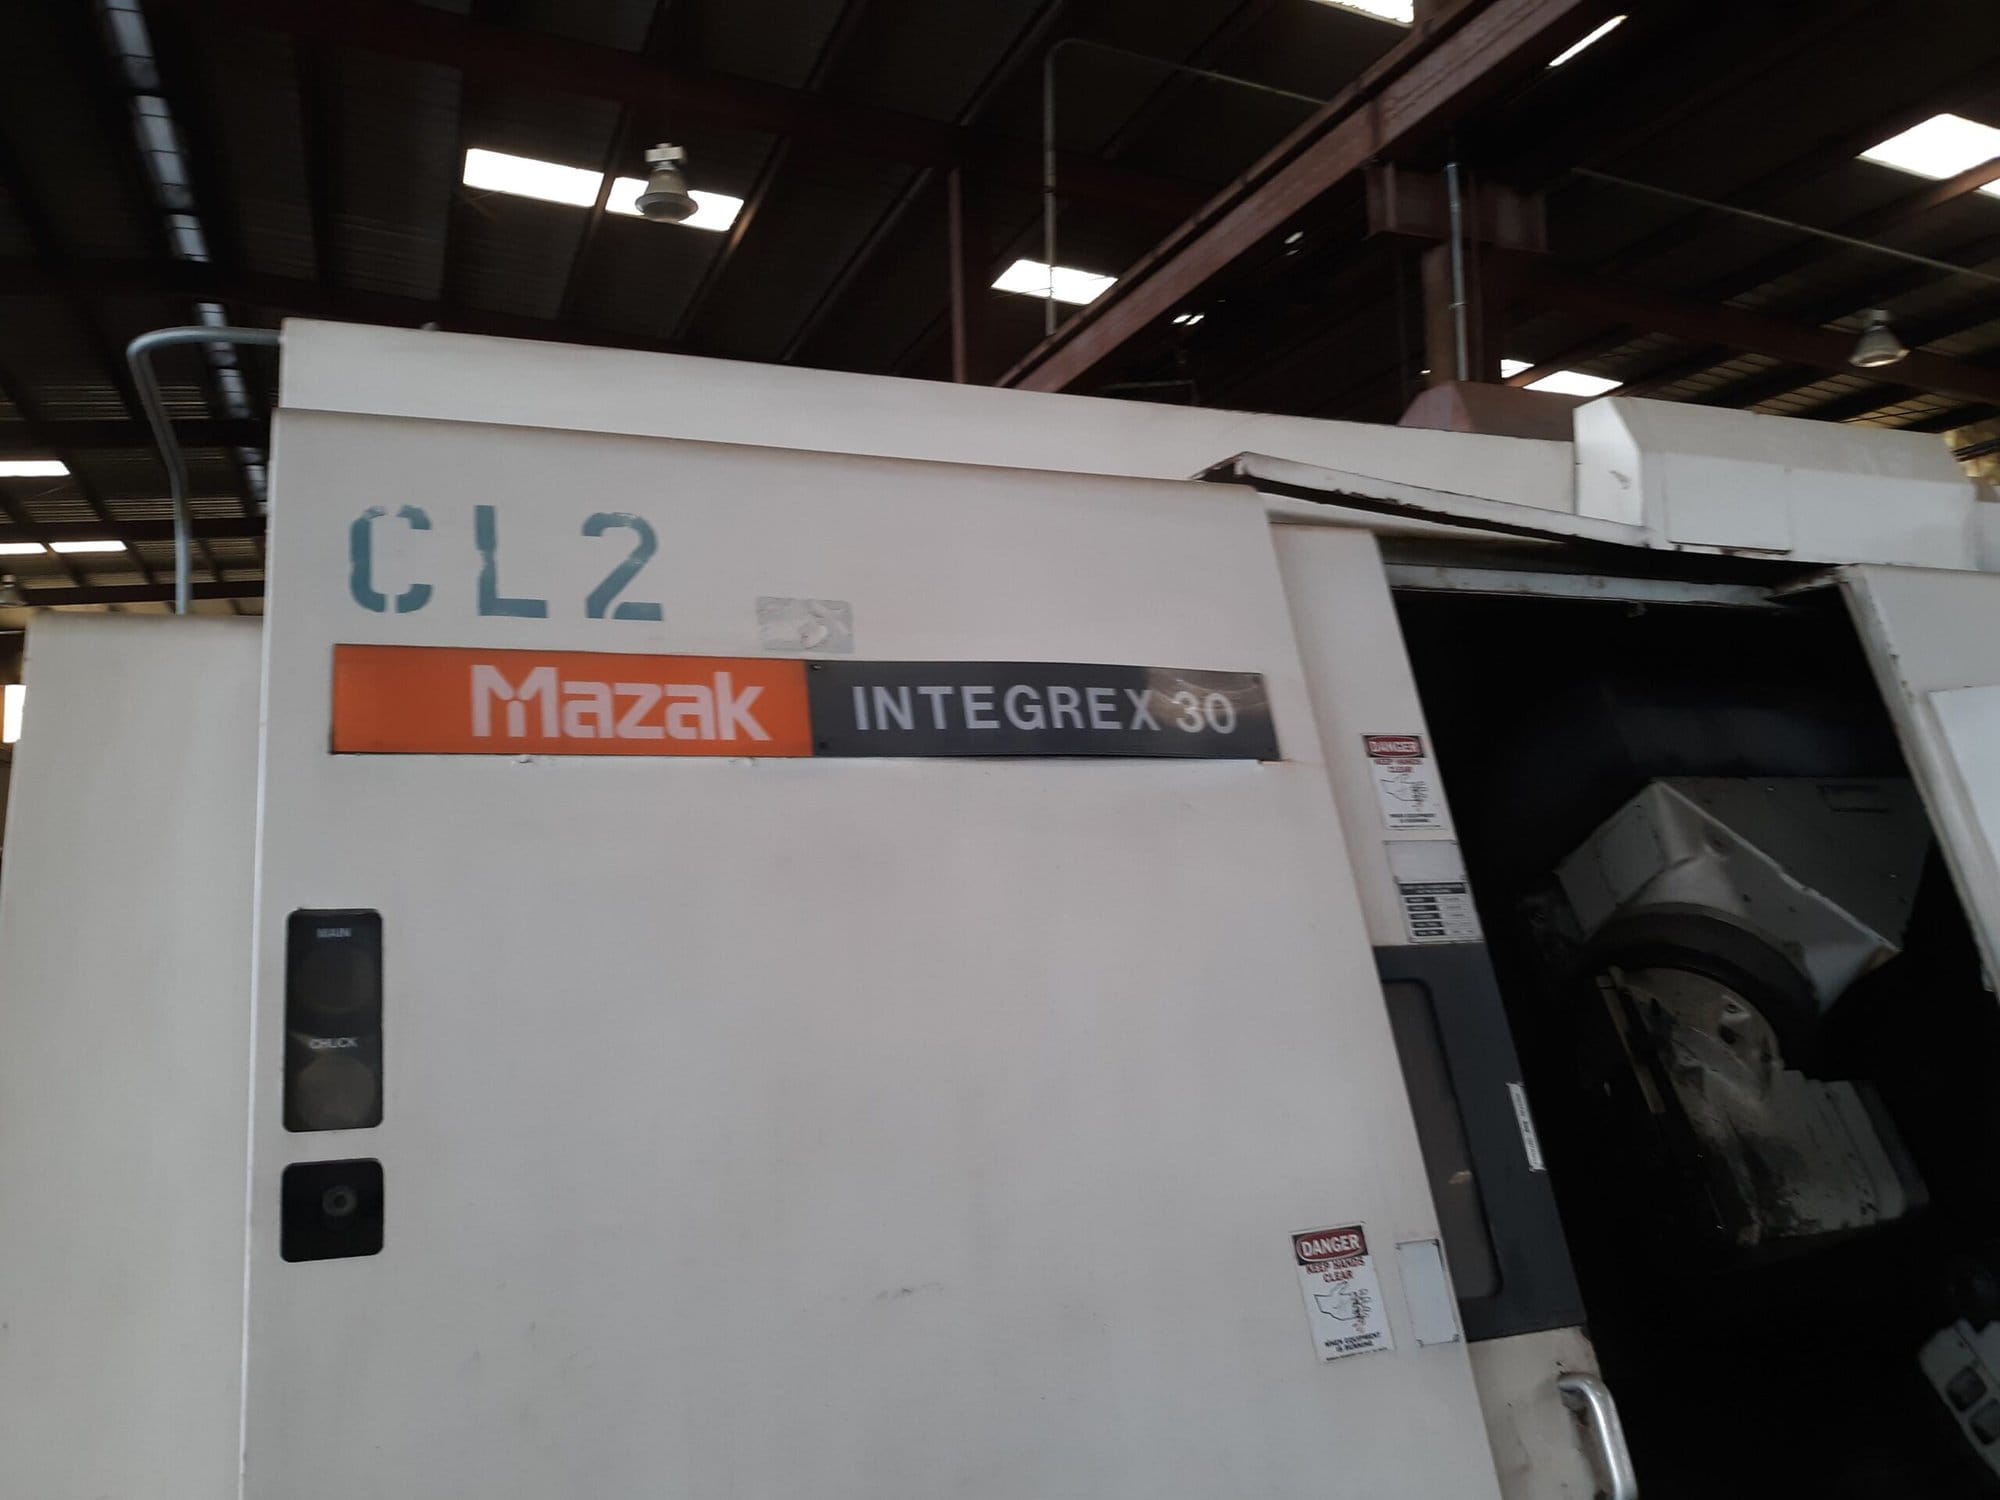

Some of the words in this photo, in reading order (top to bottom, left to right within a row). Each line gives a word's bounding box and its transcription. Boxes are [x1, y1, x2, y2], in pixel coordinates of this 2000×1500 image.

[349, 504, 664, 621] CL2
[470, 664, 772, 742] Mazak
[851, 684, 1161, 732] INTEGREX
[1175, 690, 1237, 735] 30
[1369, 741, 1418, 753] DANGER
[1301, 1234, 1361, 1256] DANGER
[1323, 1270, 1353, 1282] CLEAR
